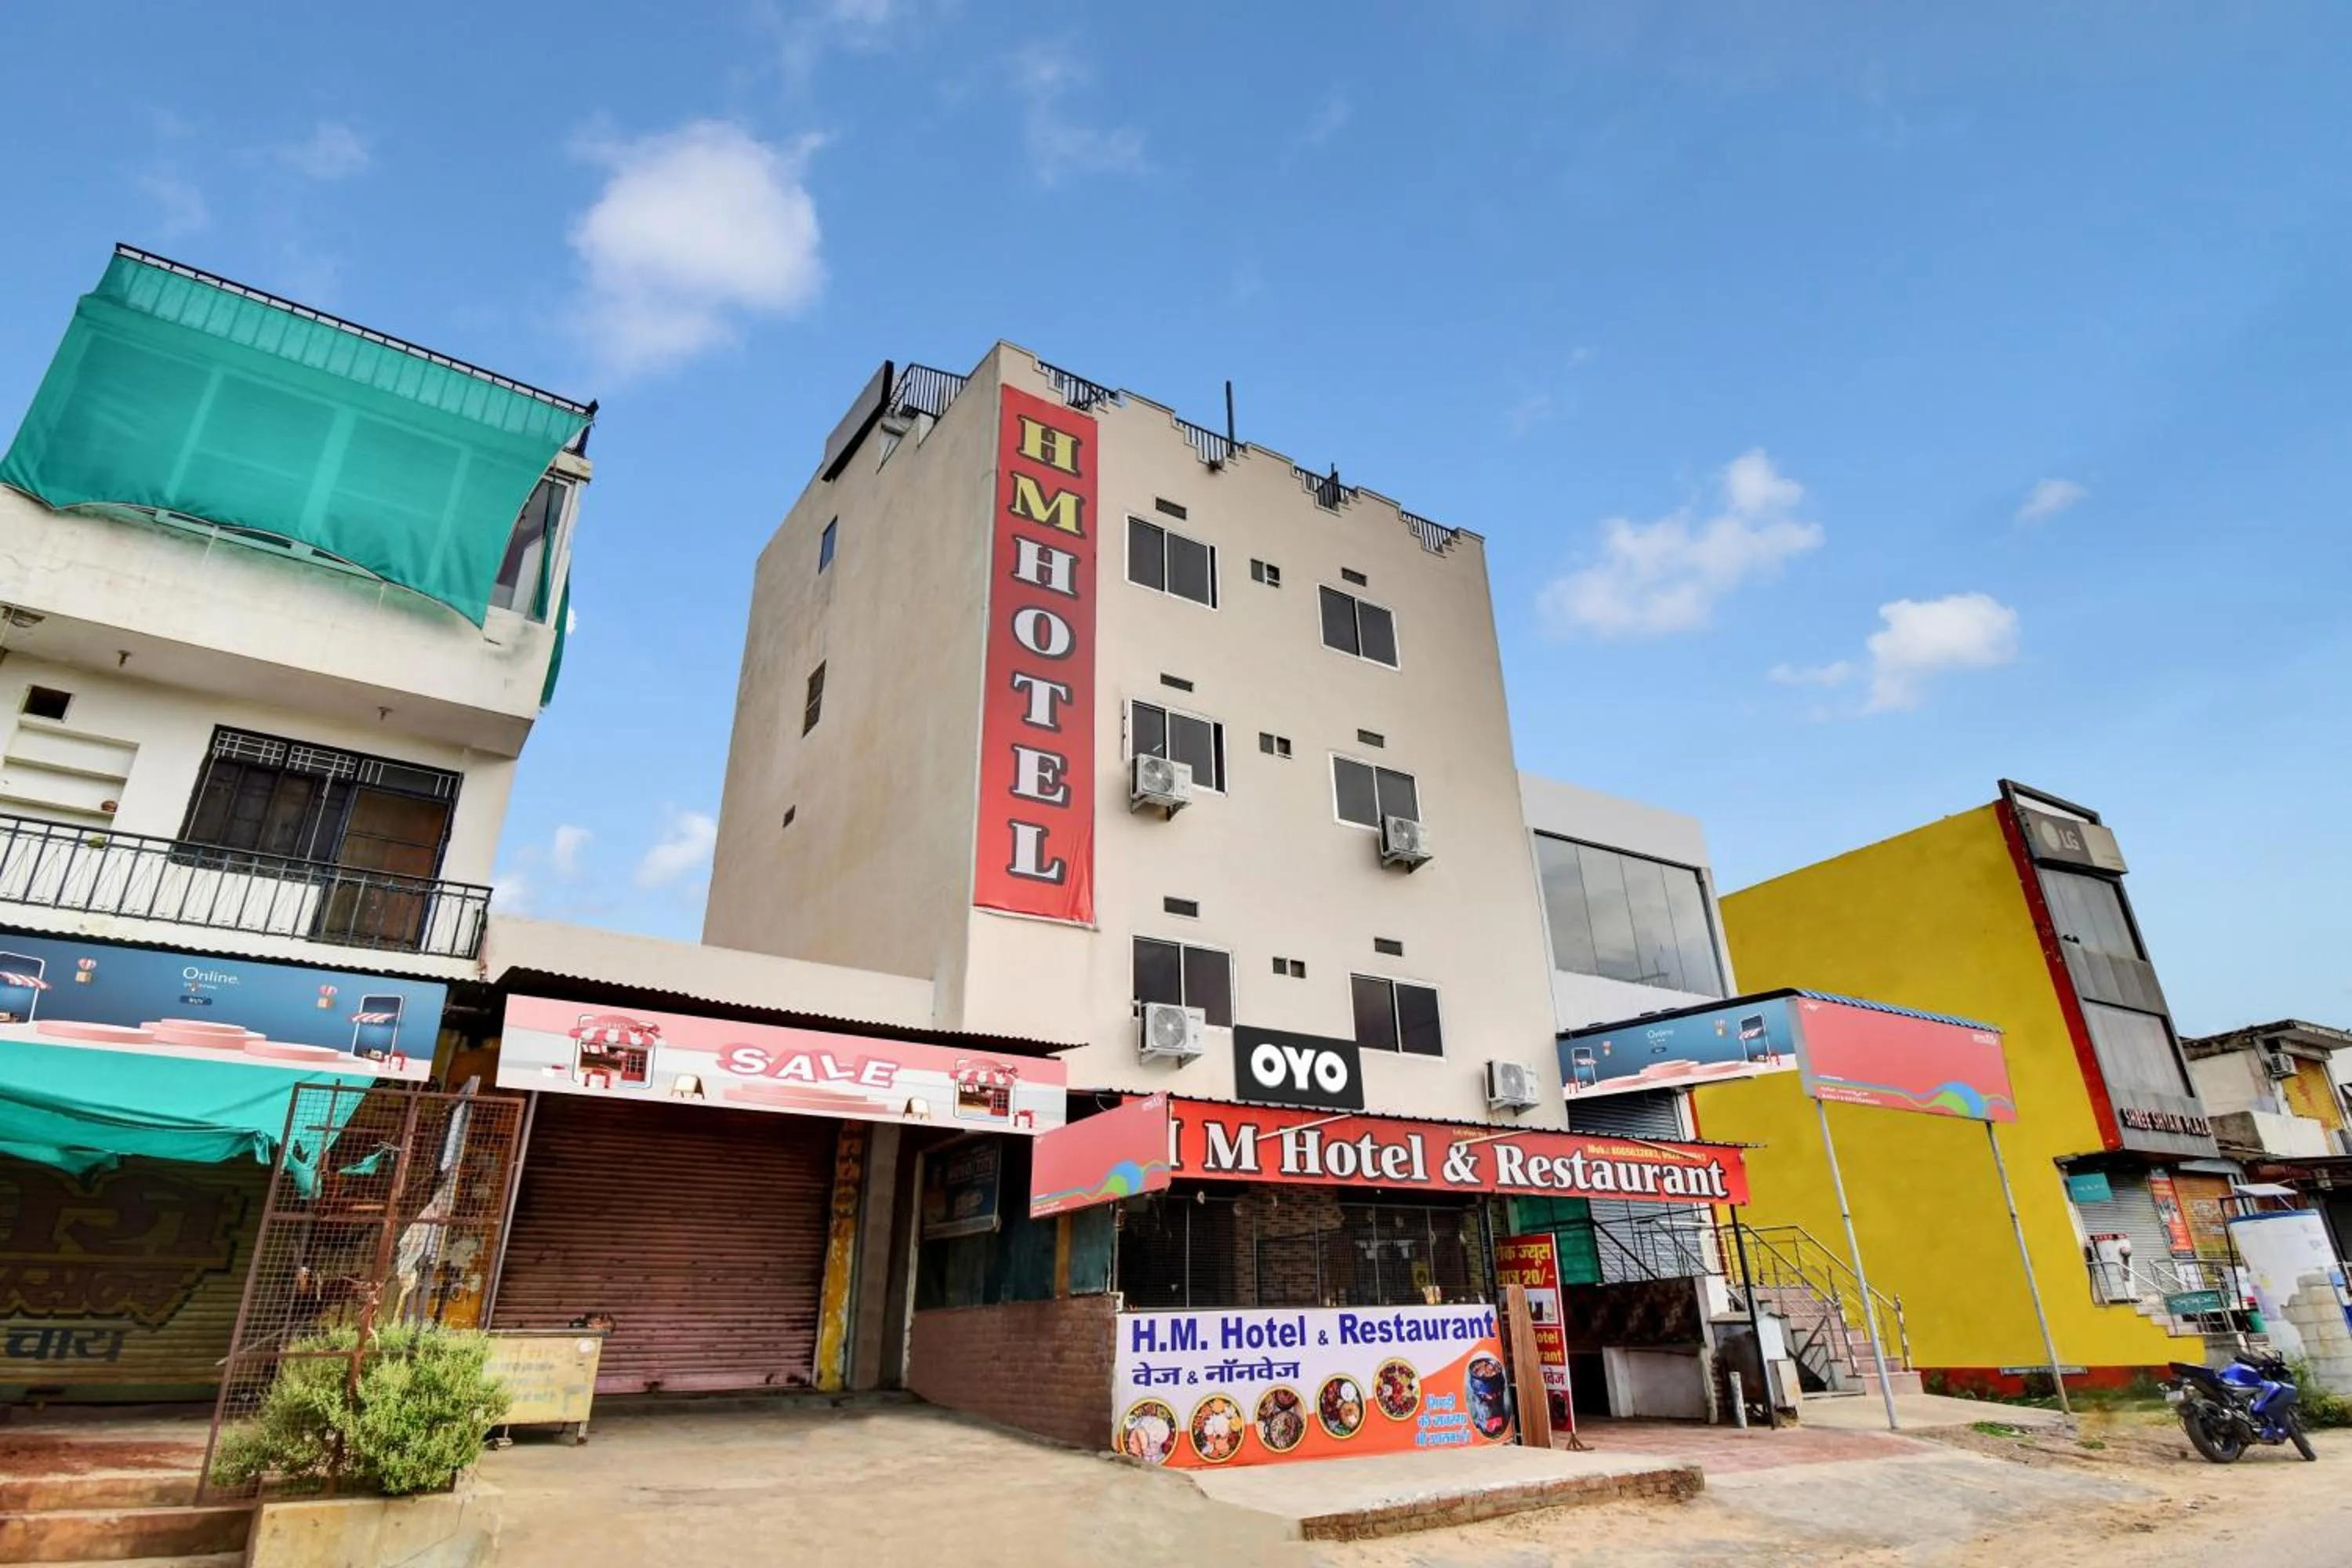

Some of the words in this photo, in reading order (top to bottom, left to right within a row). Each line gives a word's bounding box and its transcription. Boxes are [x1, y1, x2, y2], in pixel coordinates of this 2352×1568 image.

[2059, 829, 2082, 851] LG
[182, 966, 239, 985] Online
[728, 1045, 899, 1089] SALE
[1250, 1044, 1348, 1094] OYO
[1203, 1121, 1260, 1171] M
[1279, 1127, 1428, 1181] Hotel
[1443, 1141, 1481, 1183] &
[1493, 1142, 1730, 1198] Restaurant
[1522, 1267, 1555, 1287] 20/-
[1131, 1318, 1208, 1352] H.M.
[1221, 1314, 1307, 1350] Hotel
[1317, 1329, 1330, 1346] &
[1338, 1309, 1496, 1345] Restaurant
[1535, 1330, 1559, 1344] otel
[1131, 1362, 1181, 1387] वेज
[1186, 1370, 1199, 1385] &
[1204, 1356, 1301, 1383] नॉनवेज
